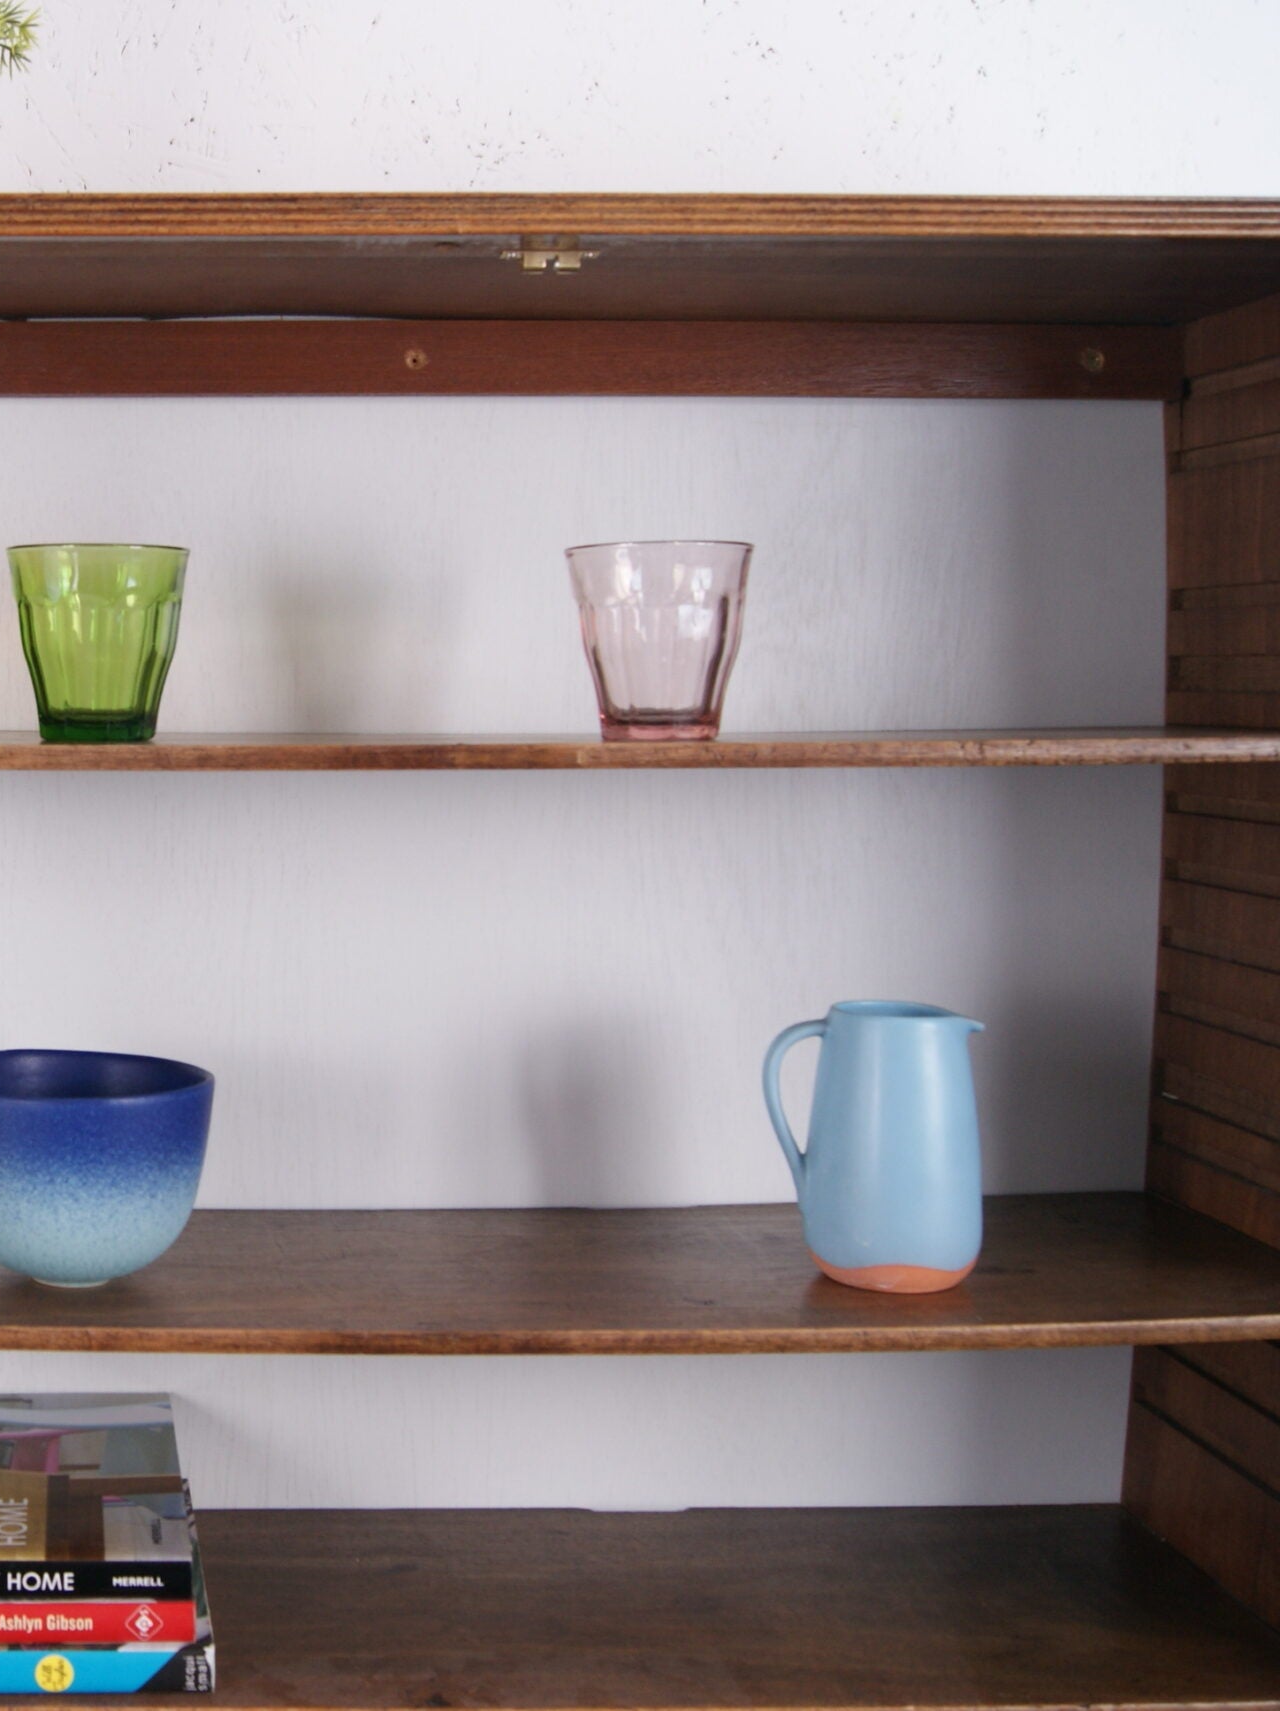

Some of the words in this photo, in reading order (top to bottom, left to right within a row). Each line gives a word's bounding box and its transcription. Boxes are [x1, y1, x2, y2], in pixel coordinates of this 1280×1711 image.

[7, 1572, 74, 1591] HOME
[112, 1576, 164, 1588] MERRELL
[46, 1614, 94, 1631] Gibson
